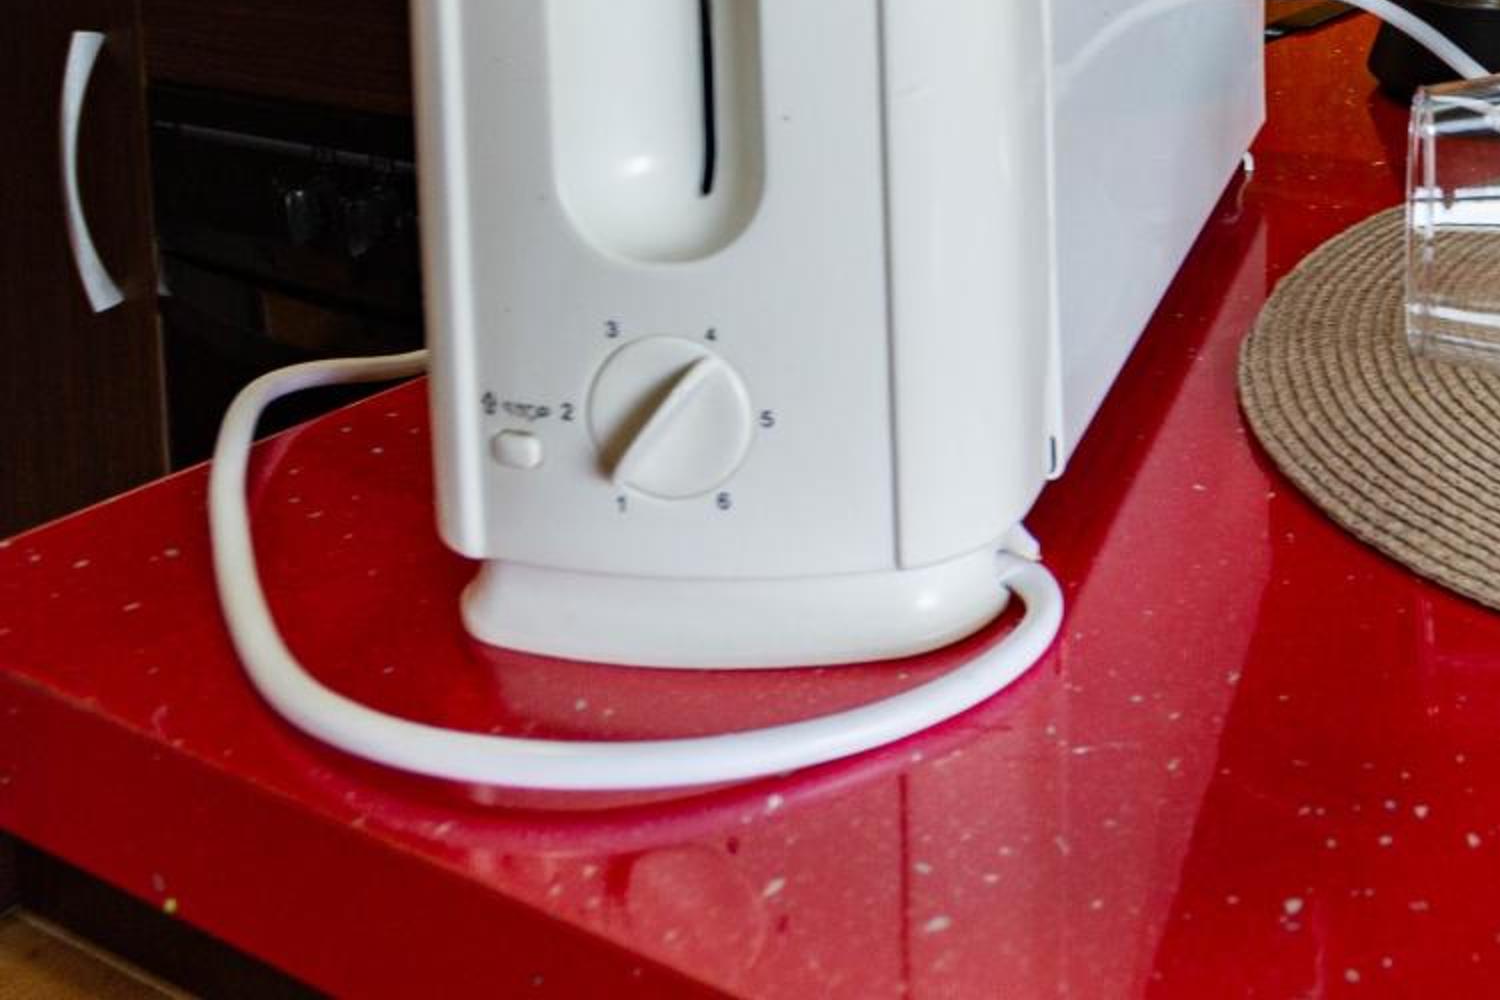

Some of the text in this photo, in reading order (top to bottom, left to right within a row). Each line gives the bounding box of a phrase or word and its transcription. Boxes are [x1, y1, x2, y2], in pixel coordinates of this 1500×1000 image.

[604, 319, 619, 339] 3
[704, 327, 717, 341] 4
[560, 401, 574, 421] 2
[760, 410, 775, 428] 5
[616, 495, 627, 513] 1
[716, 492, 731, 511] 6
